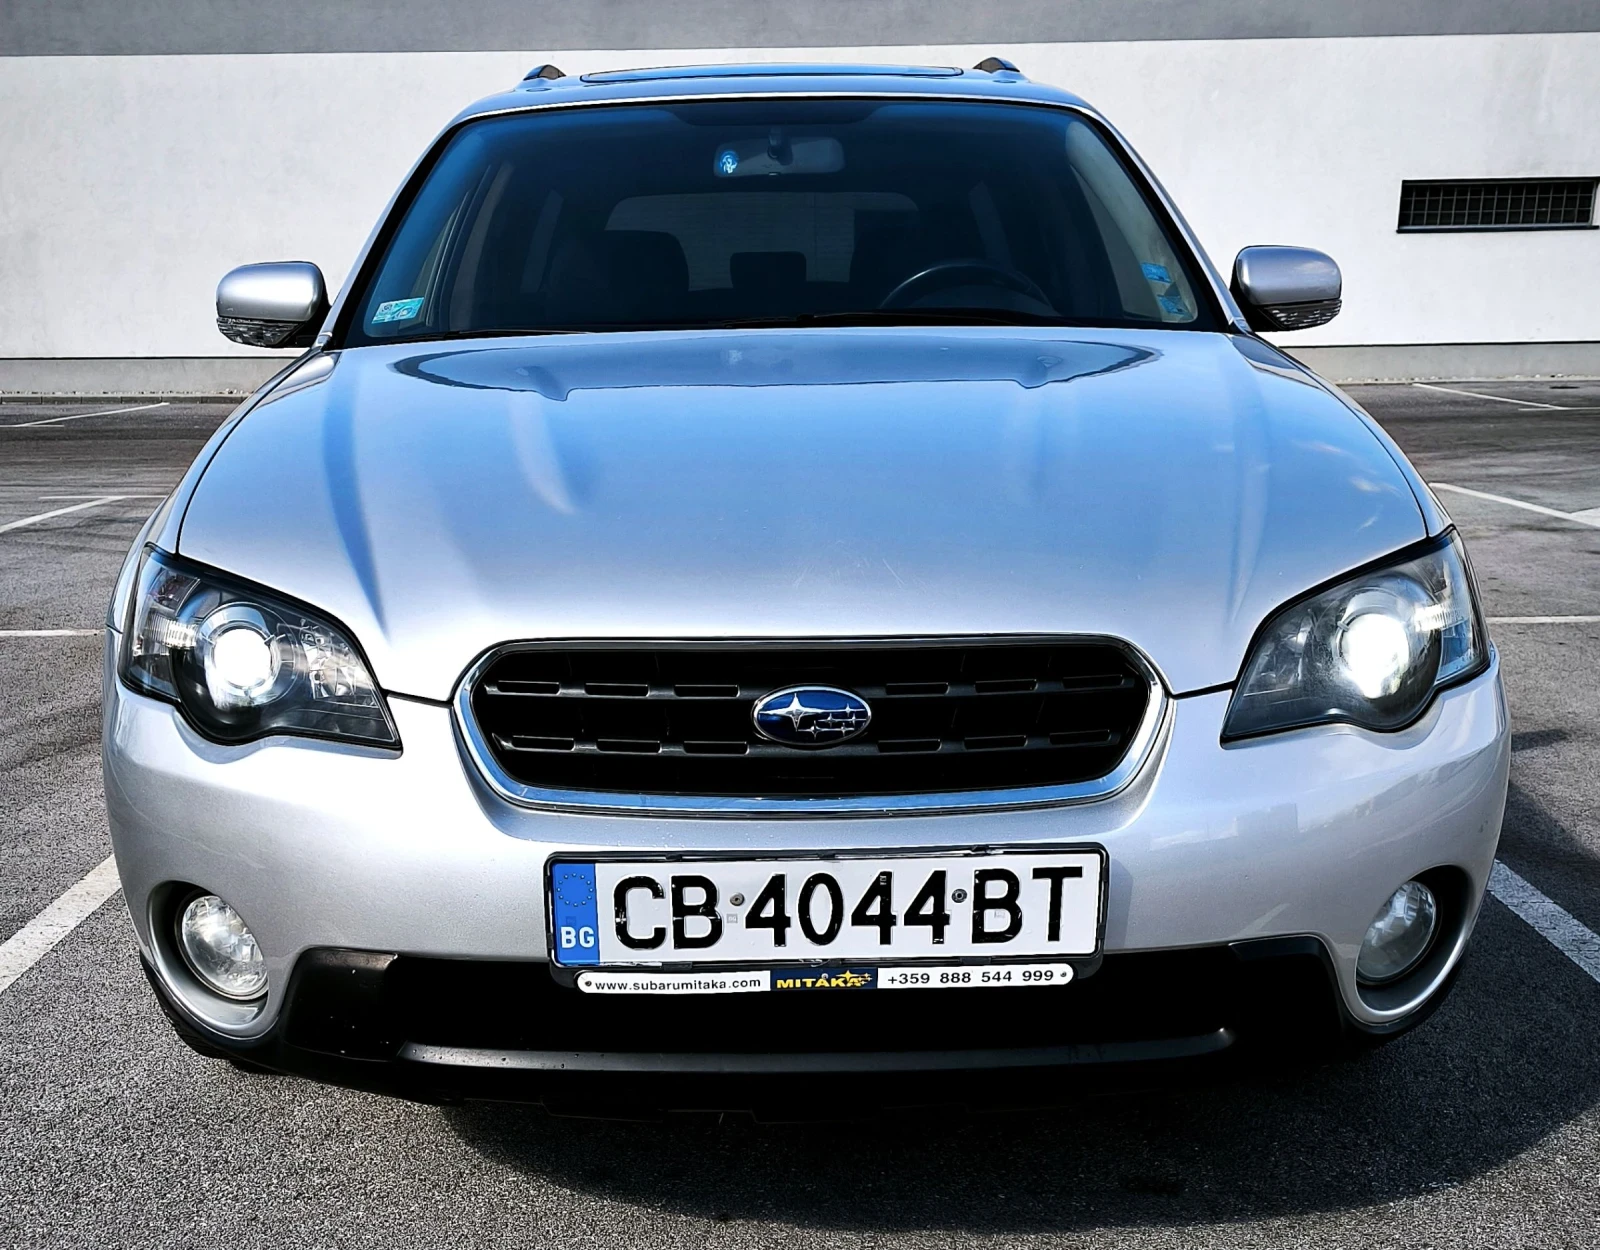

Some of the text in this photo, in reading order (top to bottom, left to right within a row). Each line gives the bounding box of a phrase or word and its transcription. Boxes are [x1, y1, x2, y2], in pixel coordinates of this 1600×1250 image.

[614, 866, 1083, 950] CB 4044 BT
[560, 926, 595, 949] BG
[595, 978, 761, 991] www.subarumitaka.com
[887, 970, 1054, 985] +359 888 544 999
